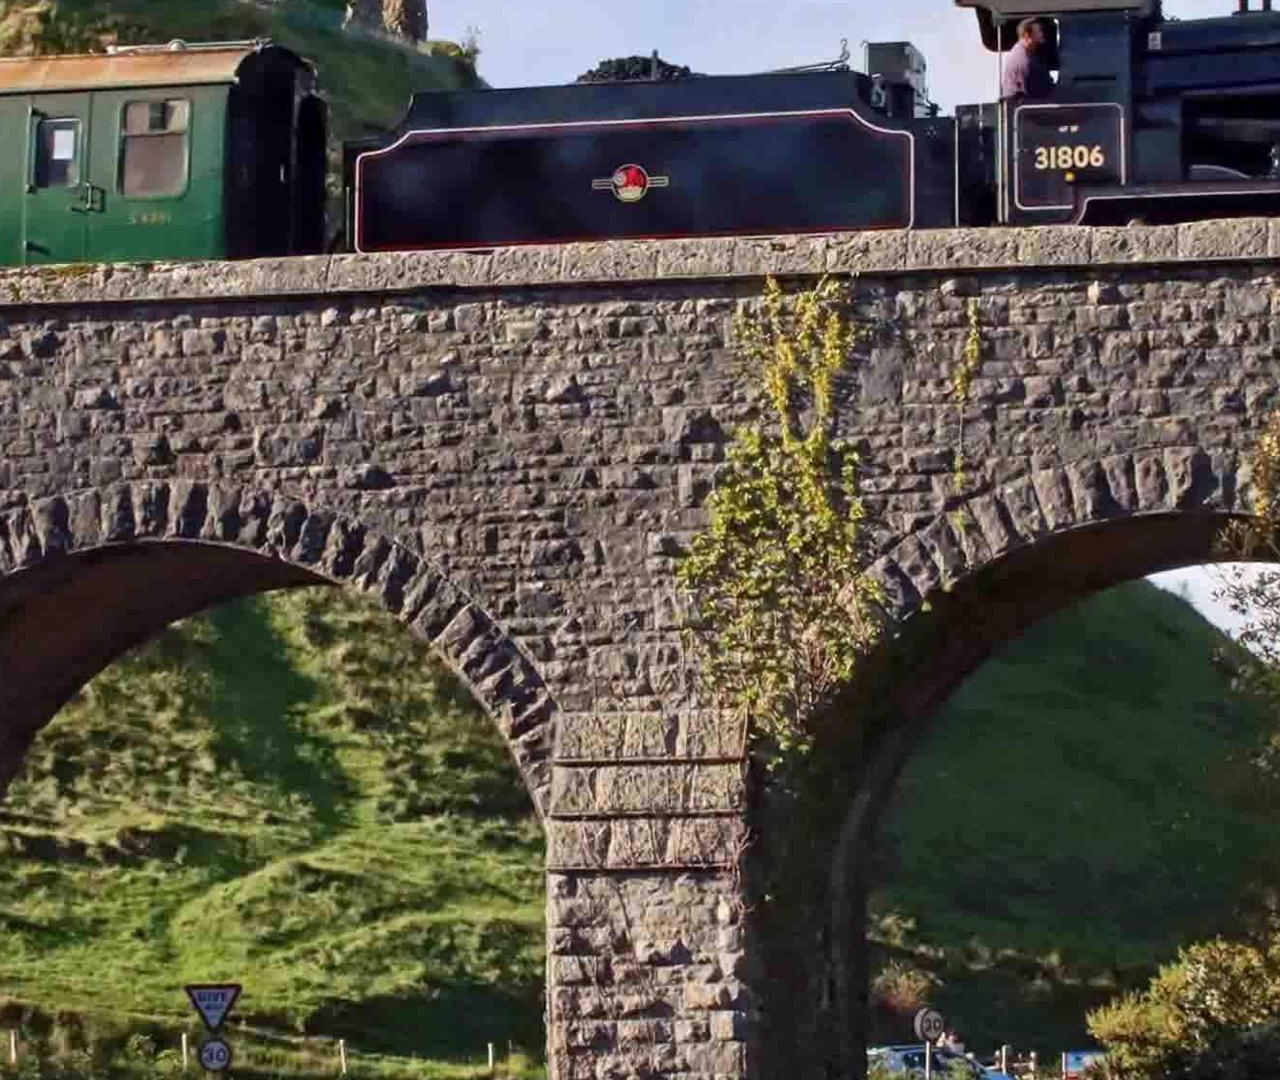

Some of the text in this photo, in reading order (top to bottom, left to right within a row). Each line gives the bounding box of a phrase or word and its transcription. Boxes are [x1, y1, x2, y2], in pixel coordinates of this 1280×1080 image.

[1034, 145, 1104, 169] 31806
[923, 1018, 942, 1031] 30
[202, 1047, 227, 1062] 30
